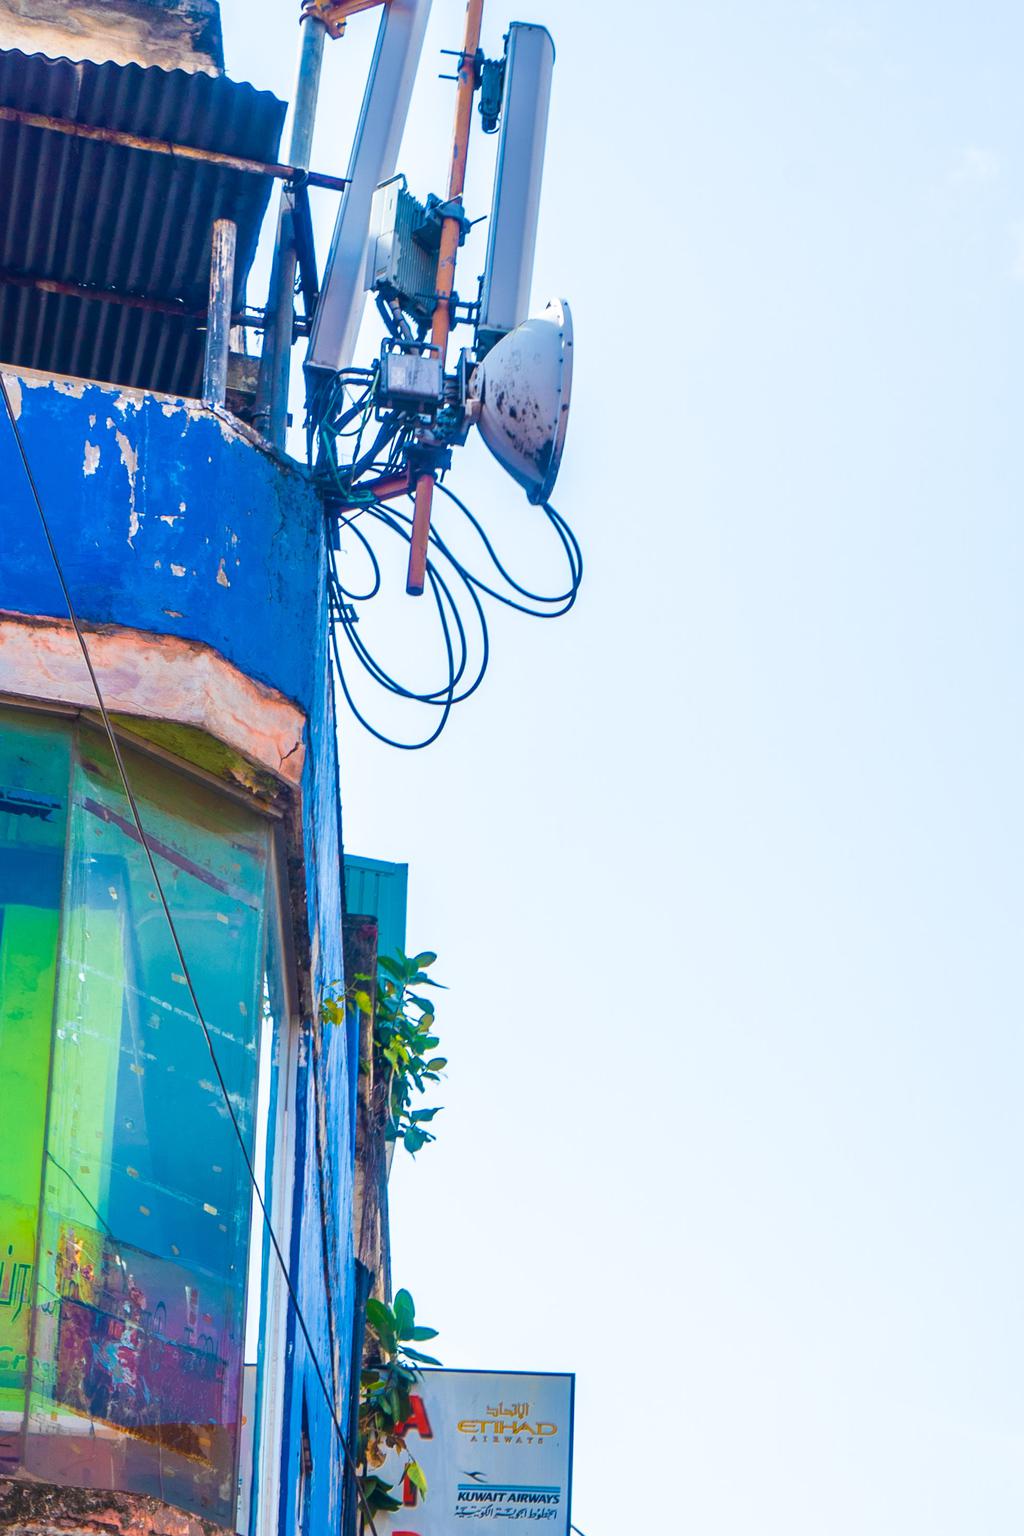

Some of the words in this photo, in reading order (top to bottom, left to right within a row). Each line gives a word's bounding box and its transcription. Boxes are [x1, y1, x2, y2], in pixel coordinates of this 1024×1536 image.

[457, 1420, 558, 1436] ETIHAD
[470, 1435, 544, 1445] AIRWAYS
[458, 1491, 506, 1502] KUWAIT
[507, 1492, 560, 1504] AIRWAYS
